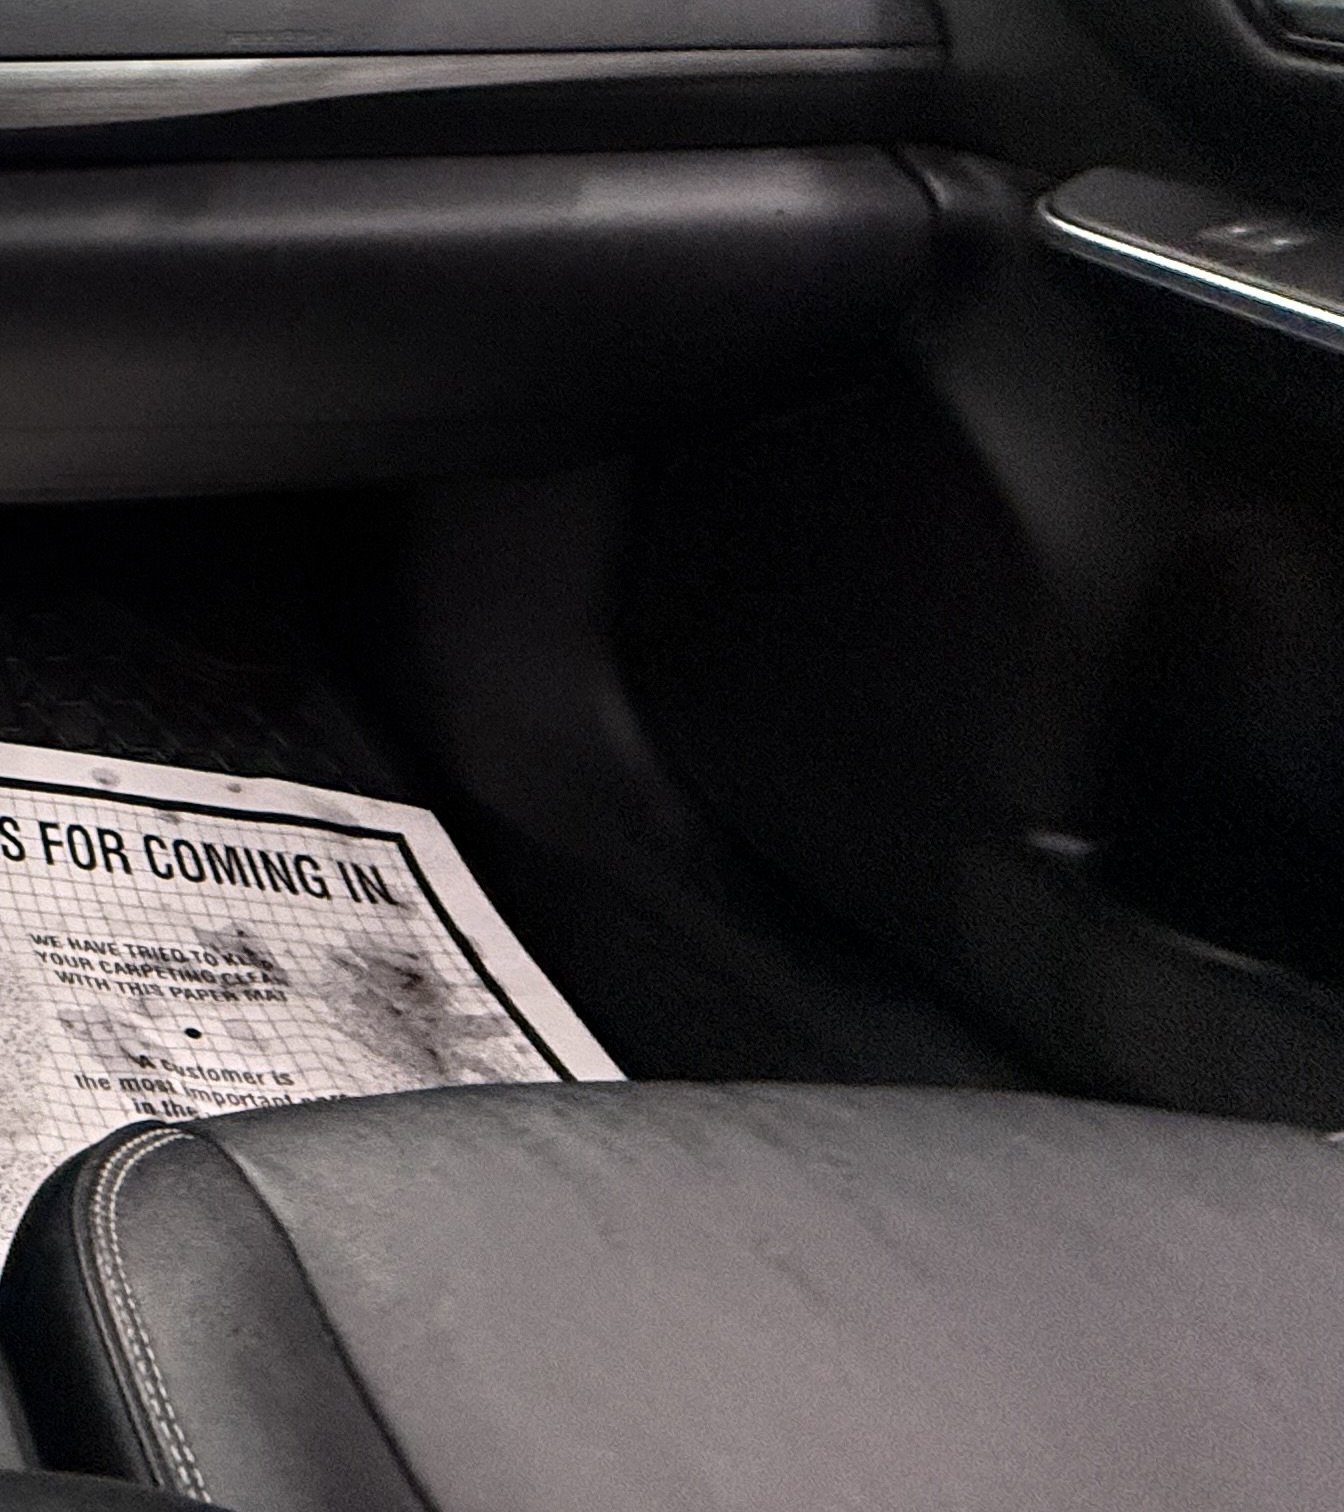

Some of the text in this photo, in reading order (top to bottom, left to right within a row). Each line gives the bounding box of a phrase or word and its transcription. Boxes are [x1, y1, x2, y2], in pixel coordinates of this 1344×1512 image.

[37, 819, 133, 876] FOR
[143, 833, 332, 901] COMING
[336, 859, 400, 906] IN
[30, 933, 63, 949] WE
[67, 936, 121, 957] HAVE
[123, 942, 189, 964] TRIED
[190, 950, 219, 967] TO
[34, 950, 95, 972] YOUR
[99, 960, 216, 985] CARPETING
[54, 969, 289, 1003] WITH THIS PAPER MAT
[160, 1058, 265, 1086] customer
[271, 1070, 295, 1087] is
[74, 1074, 112, 1091] the
[118, 1077, 177, 1095] most
[182, 1080, 293, 1109] important
[132, 1098, 199, 1118] in the
